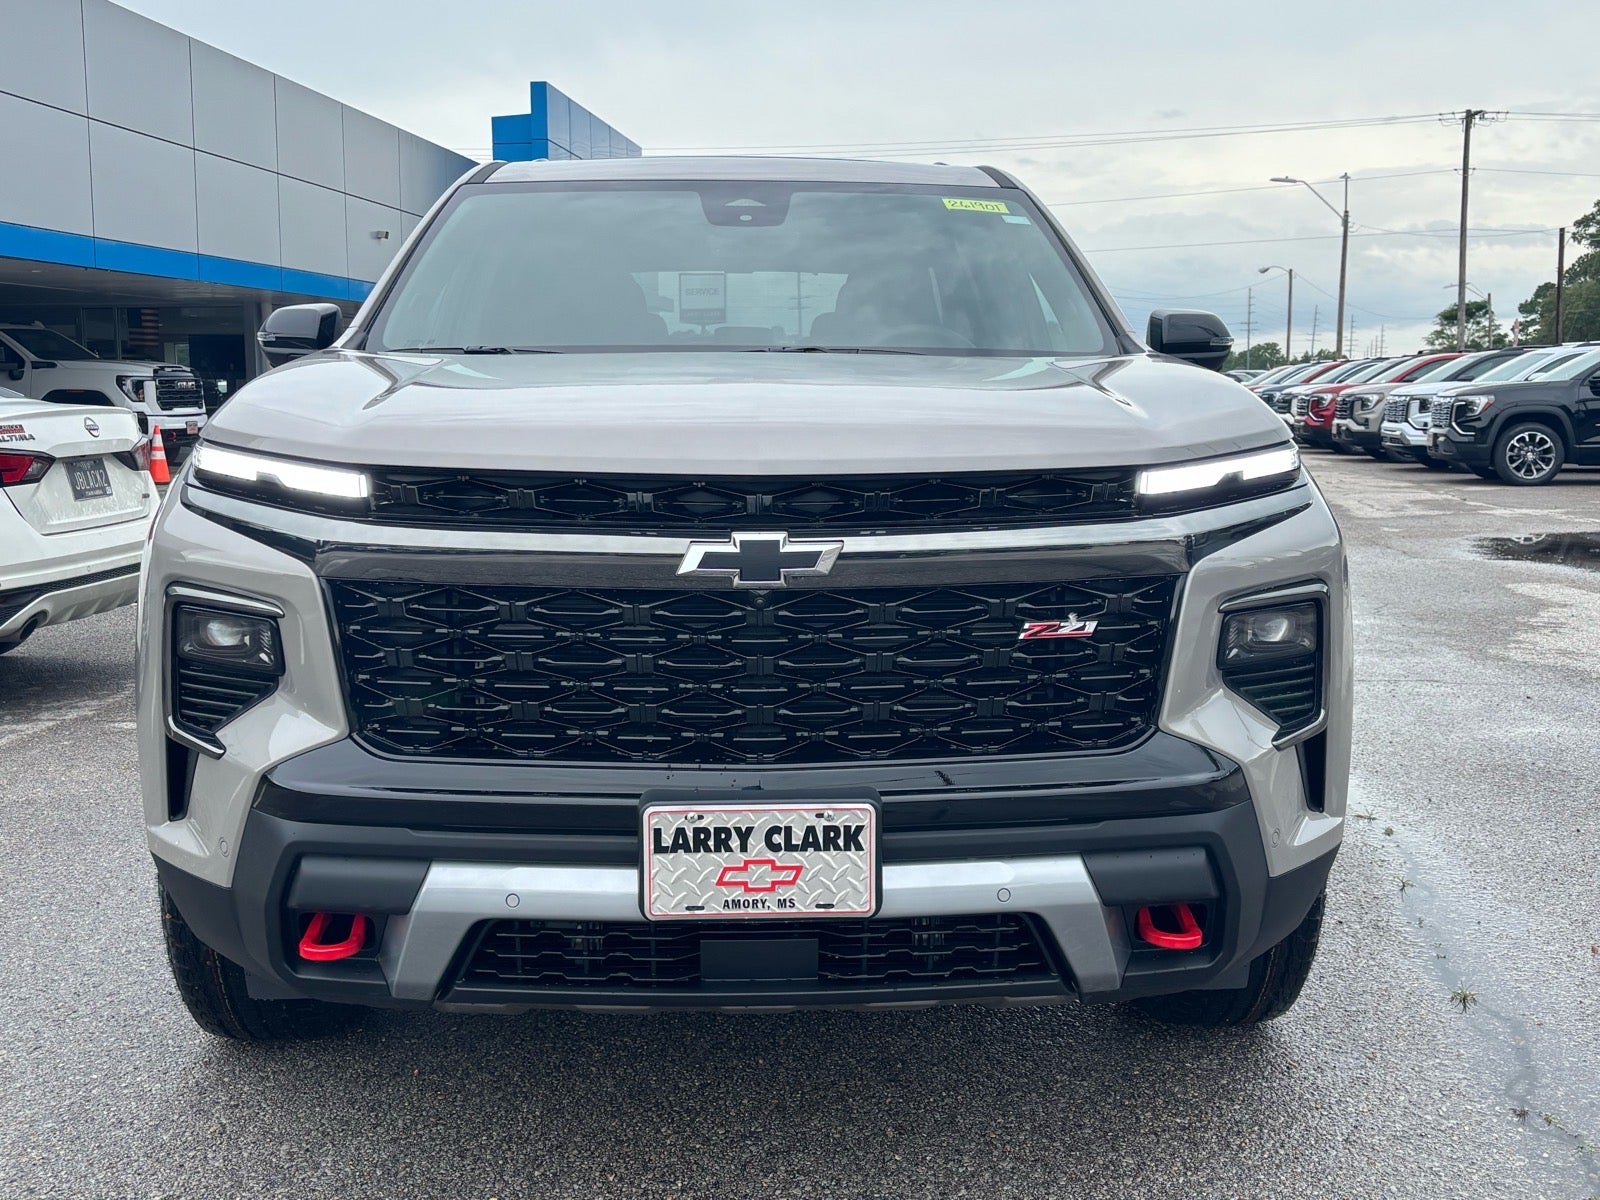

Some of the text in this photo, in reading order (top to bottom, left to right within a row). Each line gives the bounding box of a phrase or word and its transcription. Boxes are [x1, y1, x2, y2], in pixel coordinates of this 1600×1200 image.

[74, 469, 108, 490] JBLACK2
[653, 825, 865, 854] LARRY CLARK
[722, 898, 796, 910] AMORY, MS
